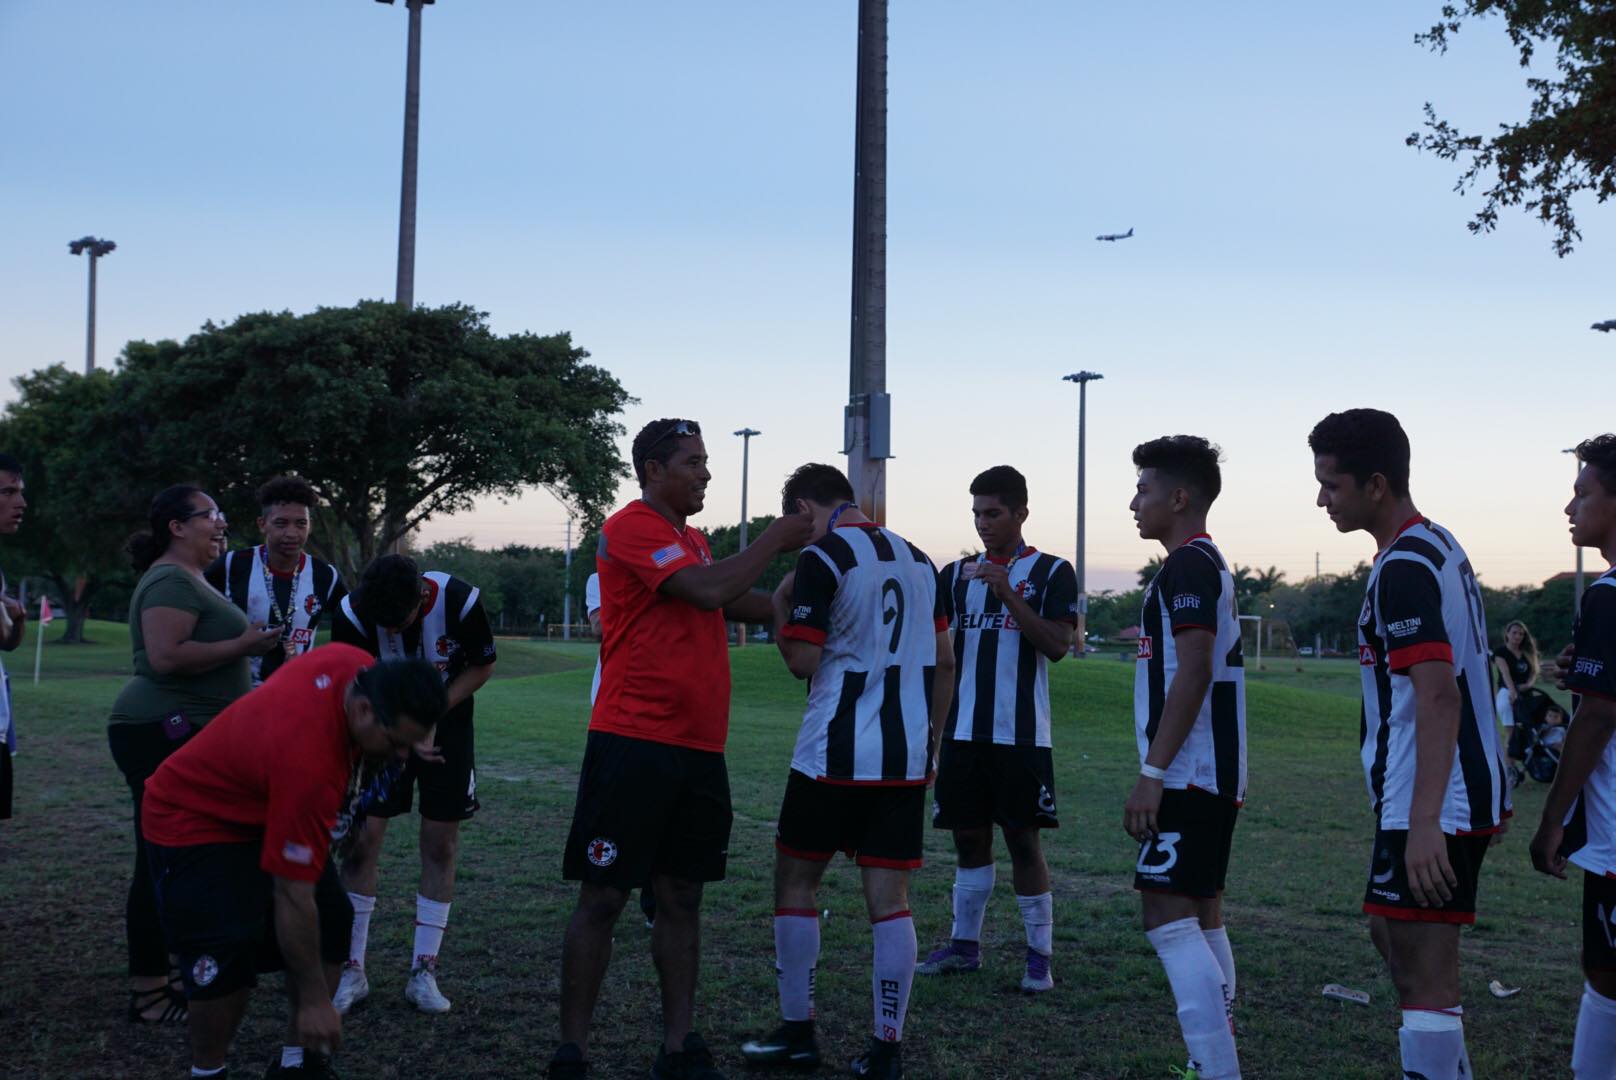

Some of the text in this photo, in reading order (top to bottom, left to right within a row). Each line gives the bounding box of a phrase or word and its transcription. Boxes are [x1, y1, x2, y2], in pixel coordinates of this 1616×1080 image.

[882, 578, 905, 654] 9
[960, 612, 1004, 630] ELITE
[1387, 616, 1422, 632] MELTINI
[1137, 638, 1152, 657] SA
[881, 979, 899, 1020] ELITE
